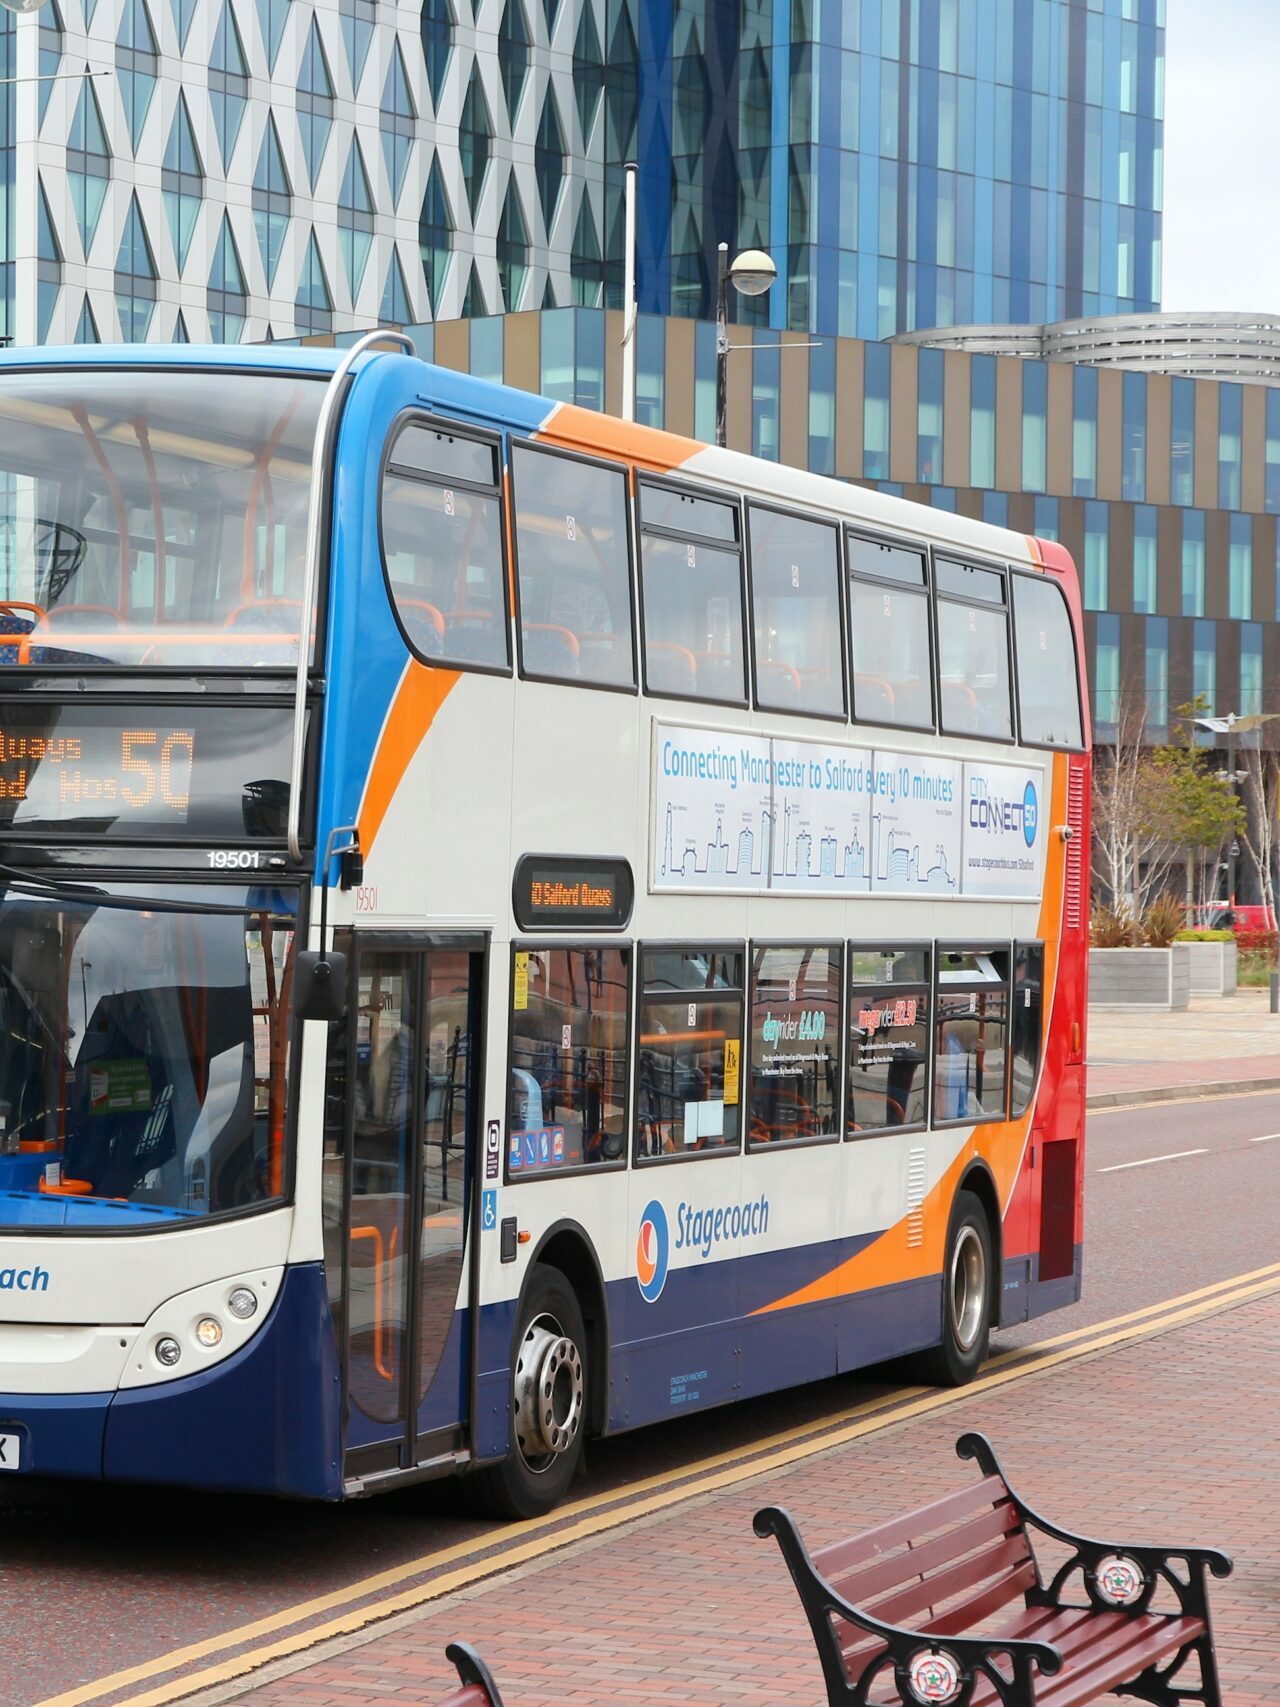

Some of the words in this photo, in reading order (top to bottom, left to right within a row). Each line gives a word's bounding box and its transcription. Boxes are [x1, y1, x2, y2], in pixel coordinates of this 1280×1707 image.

[122, 732, 194, 808] 50
[663, 741, 738, 789] Connecting
[740, 749, 806, 788] Manchester
[809, 759, 822, 789] to
[825, 758, 863, 793] Salford
[866, 768, 896, 804] every
[898, 767, 910, 799] 10
[970, 796, 1024, 835] CONNECT
[1024, 803, 1036, 827] 50
[207, 851, 260, 868] 19501
[356, 887, 378, 911] 19501
[543, 882, 579, 905] Salford
[581, 883, 612, 906] Quays
[763, 1011, 799, 1050] dayrider
[799, 1010, 826, 1041] £4.00
[675, 1192, 769, 1258] Stagecoach
